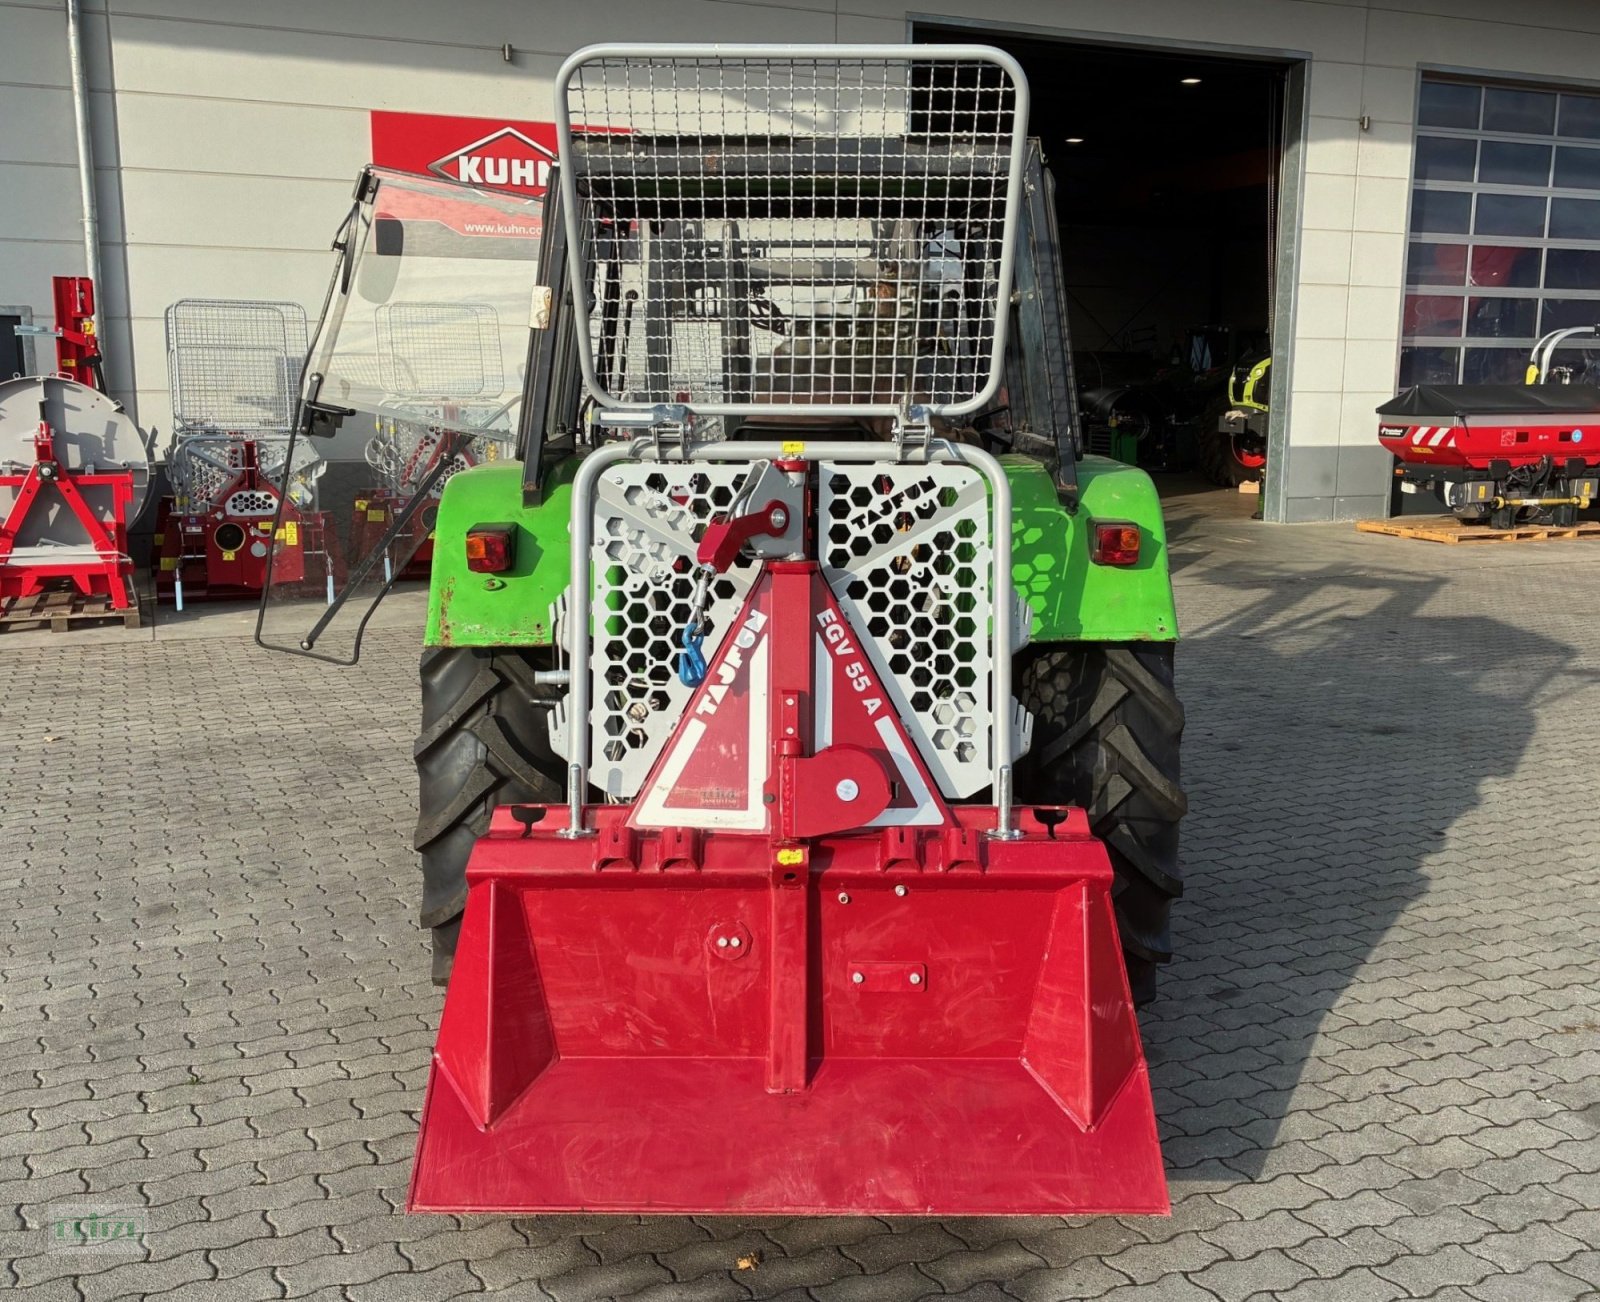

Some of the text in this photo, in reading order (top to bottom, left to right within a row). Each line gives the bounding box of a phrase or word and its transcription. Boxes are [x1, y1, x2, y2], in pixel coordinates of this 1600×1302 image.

[464, 223, 543, 235] www.kuhn.co
[695, 608, 768, 716] TAJFUN
[816, 608, 883, 716] EGV 55 A
